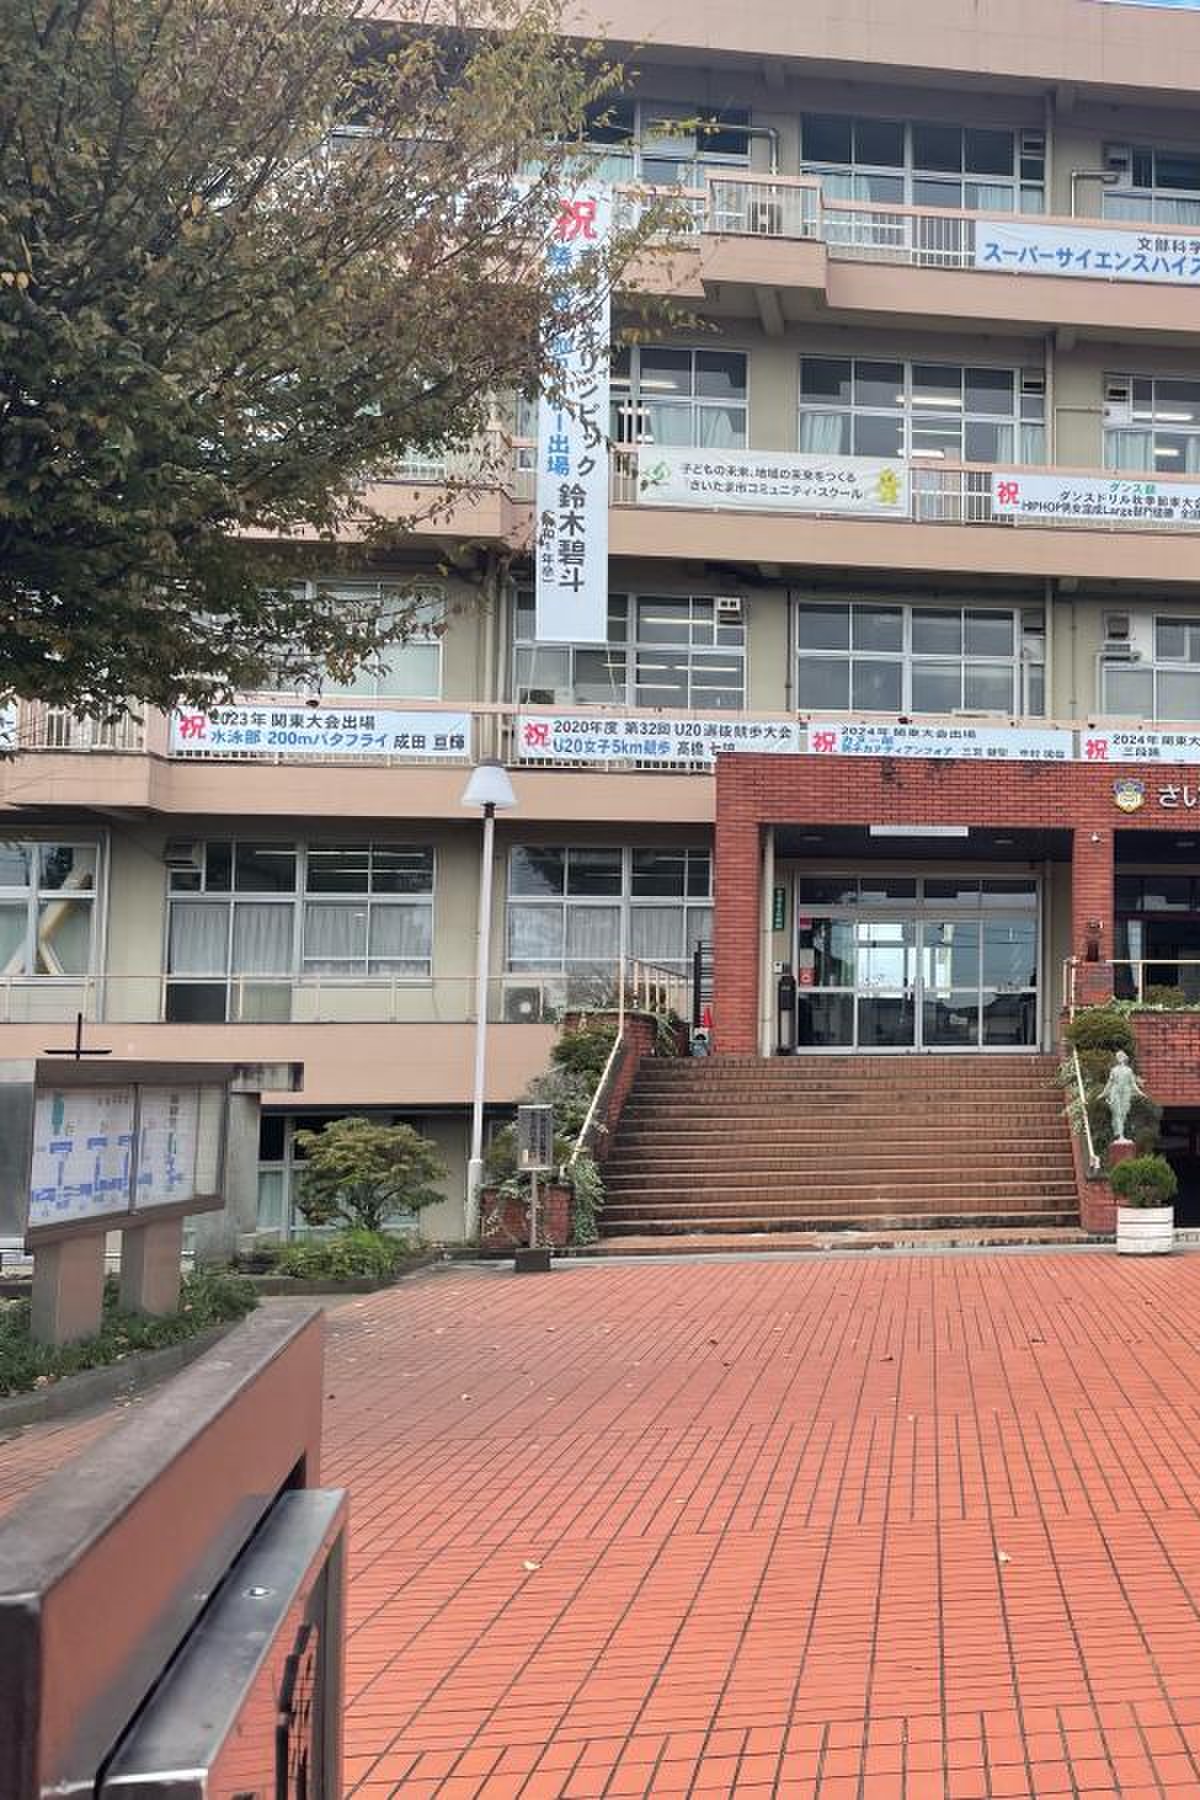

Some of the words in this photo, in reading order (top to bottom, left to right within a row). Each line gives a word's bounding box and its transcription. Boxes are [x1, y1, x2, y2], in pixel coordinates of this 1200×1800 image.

[998, 481, 1019, 505] 祝
[179, 715, 205, 739] 祝
[524, 723, 549, 748] 祝
[812, 732, 836, 752] 祝
[1085, 739, 1108, 760] 祝
